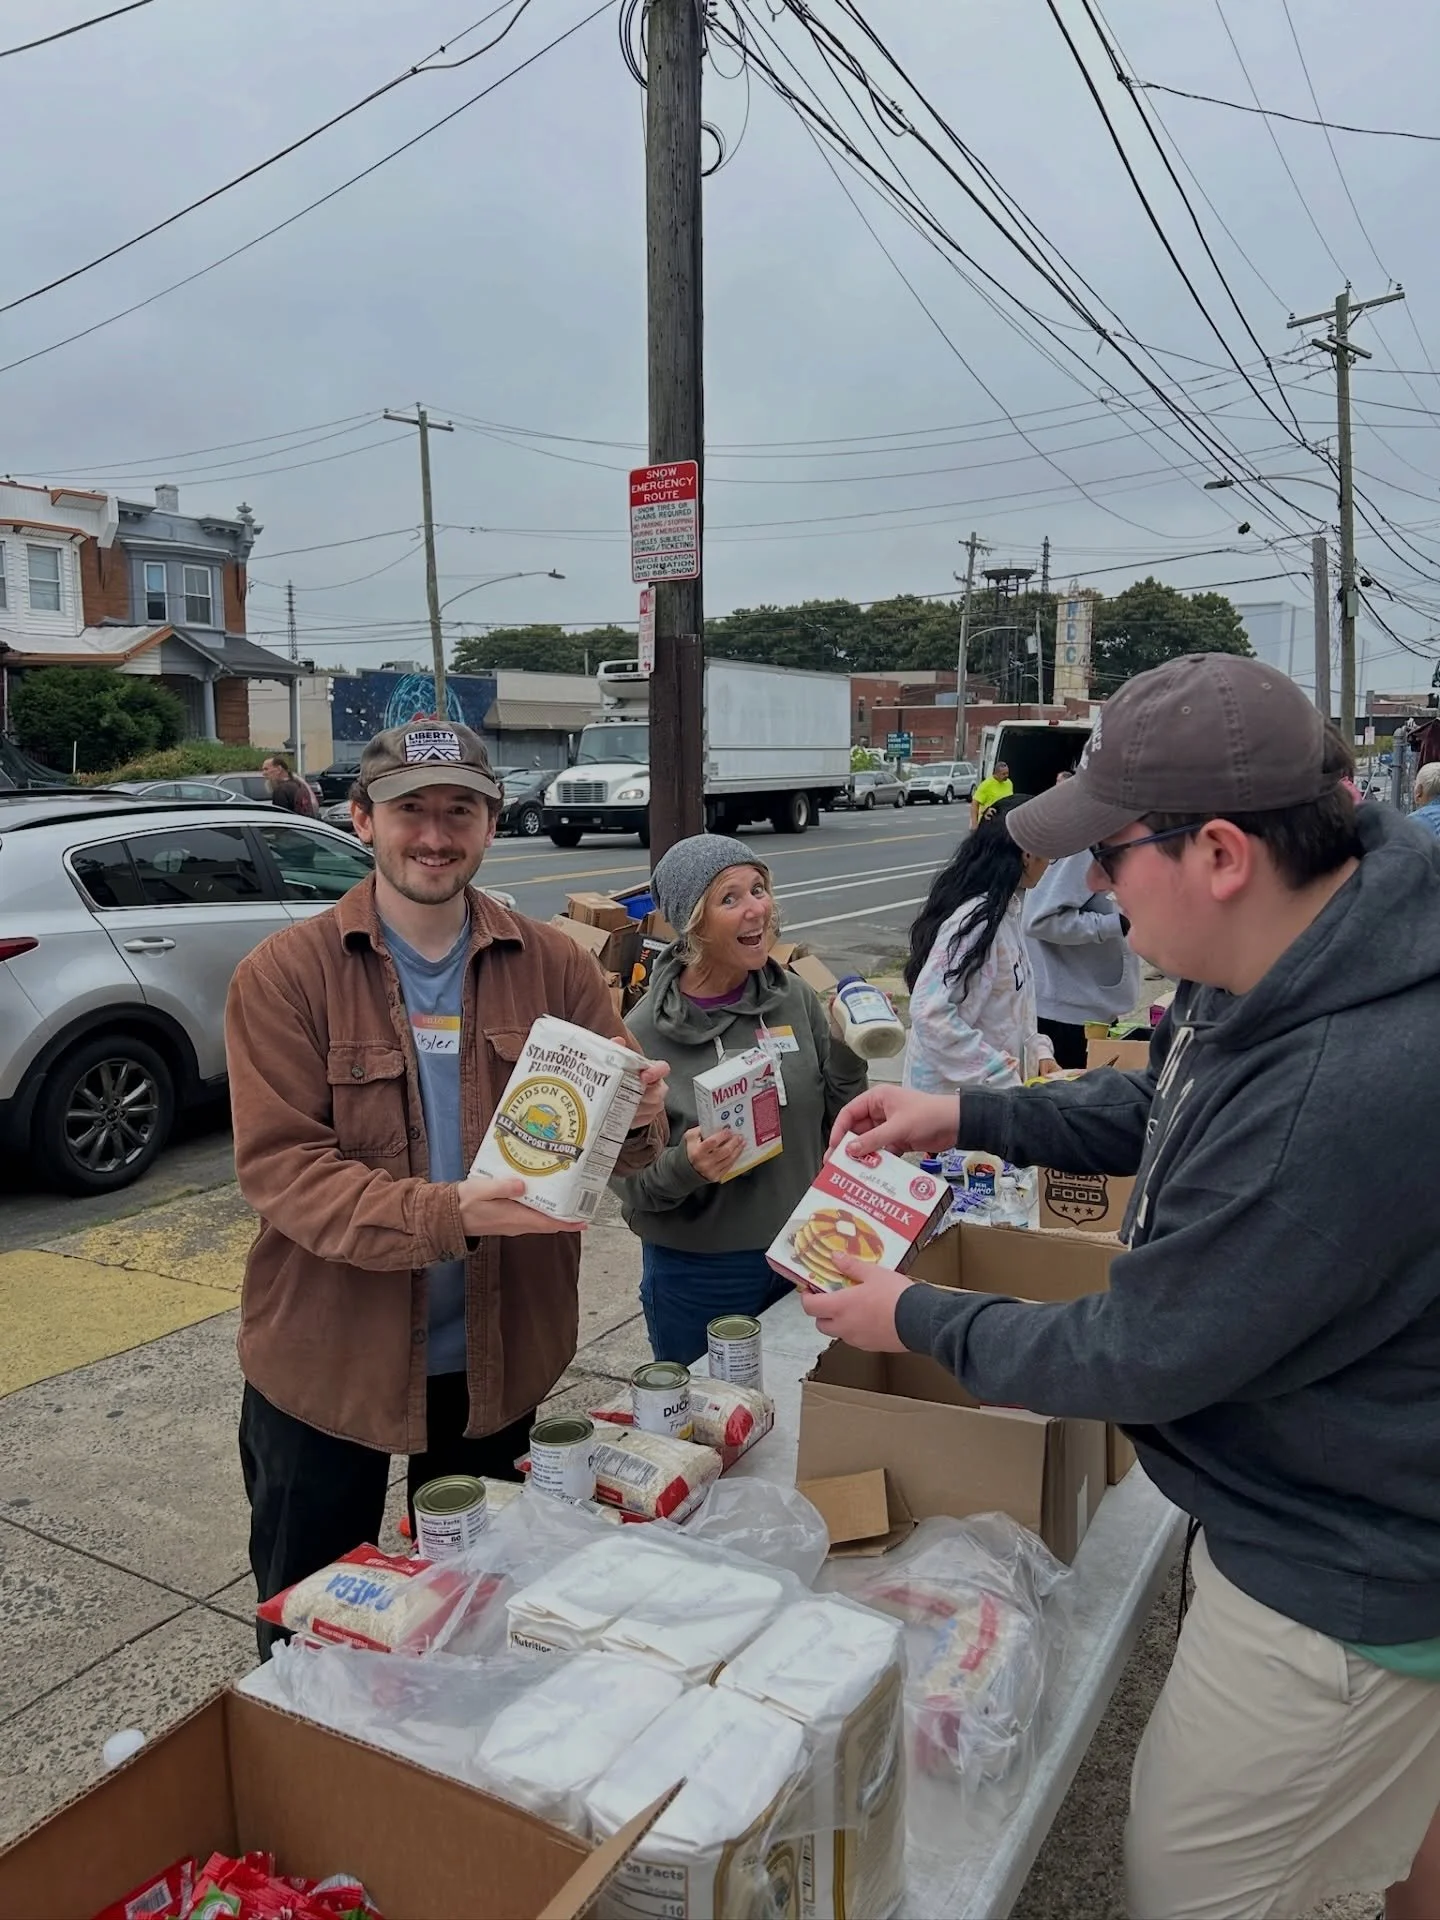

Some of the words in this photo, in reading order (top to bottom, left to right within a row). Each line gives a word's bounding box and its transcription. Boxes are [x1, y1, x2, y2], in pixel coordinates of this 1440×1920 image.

[646, 467, 677, 479] SNOW
[631, 476, 694, 493] EMERGENCY
[643, 490, 680, 502] ROUTE
[634, 513, 656, 521] CHAINS
[658, 508, 692, 518] REQUIRED
[637, 506, 655, 514] SNOW
[657, 503, 676, 511] TIRES
[634, 560, 695, 571] INFORMATION
[635, 556, 659, 565] VEHICLE
[660, 553, 694, 562] LOCATION
[408, 732, 454, 740] LIBERTY
[560, 1044, 589, 1060] THE
[526, 1043, 577, 1070] STAFFORD
[576, 1063, 611, 1087] COUNTY
[528, 1061, 561, 1075] FLOUR
[560, 1068, 583, 1087] MILLS
[712, 1077, 748, 1107] MAYPO
[510, 1086, 559, 1114] HUDSON
[560, 1095, 578, 1139] CREAM
[497, 1117, 513, 1130] ALL
[512, 1126, 548, 1150] PURPOSE
[548, 1143, 577, 1156] FLOUR
[830, 1172, 914, 1226] BUTTERMILK
[1051, 1187, 1101, 1202] FOOD
[359, 1569, 388, 1582] RICE
[645, 1865, 684, 1880] Facts
